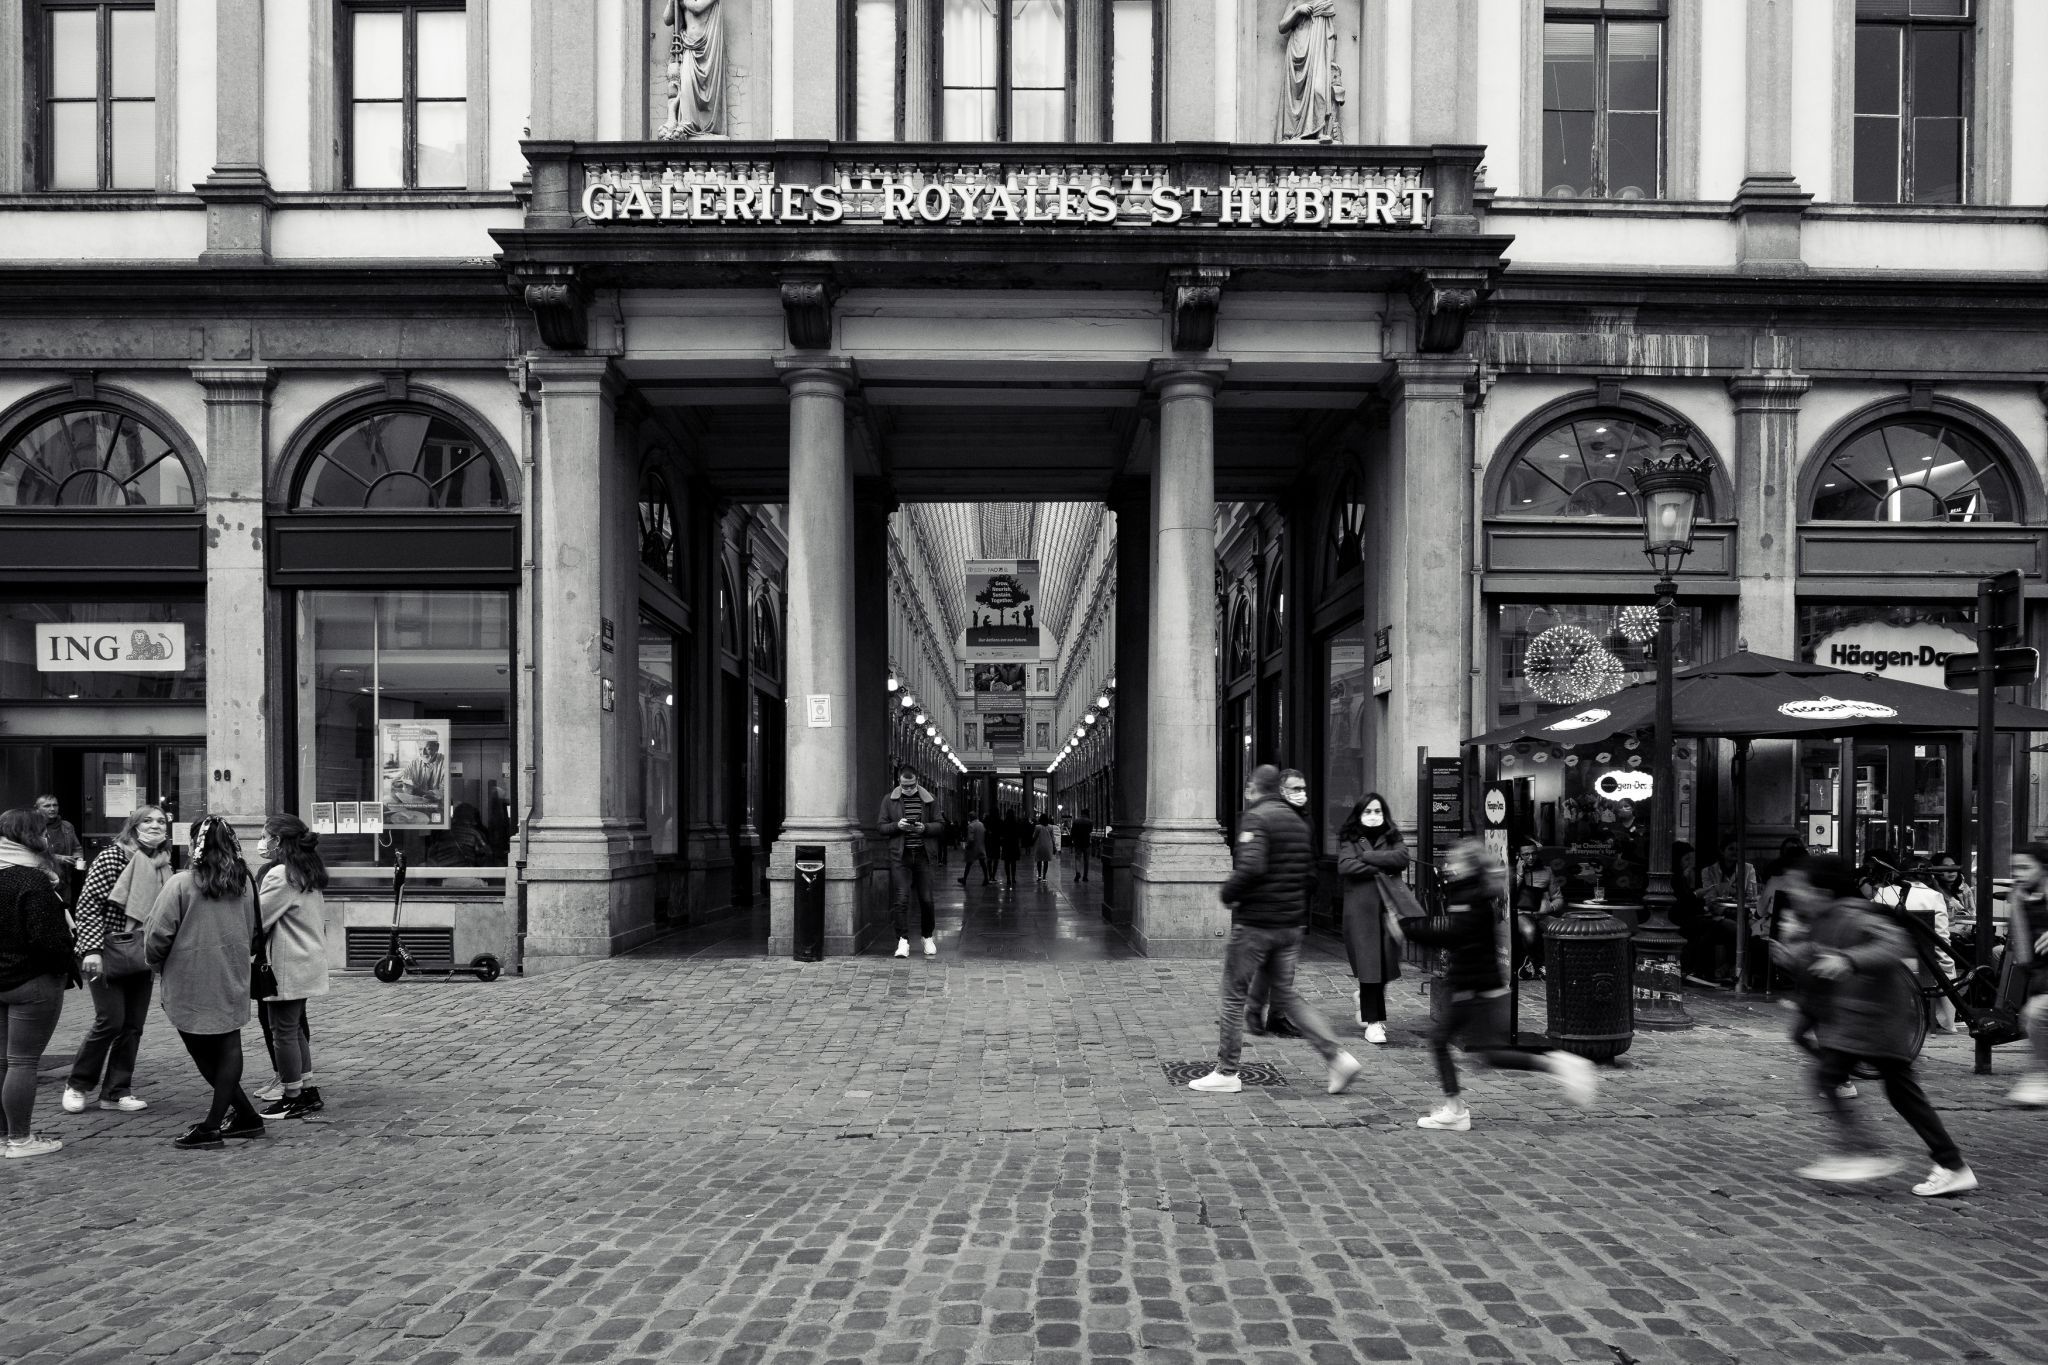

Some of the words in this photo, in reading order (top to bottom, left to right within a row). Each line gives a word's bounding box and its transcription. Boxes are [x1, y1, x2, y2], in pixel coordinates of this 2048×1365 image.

[582, 183, 843, 223] GALERIES
[882, 184, 1118, 223] ROYALES
[1219, 186, 1435, 225] HUBERT
[48, 635, 120, 661] ING
[1831, 644, 1953, 671] Häagen-Da
